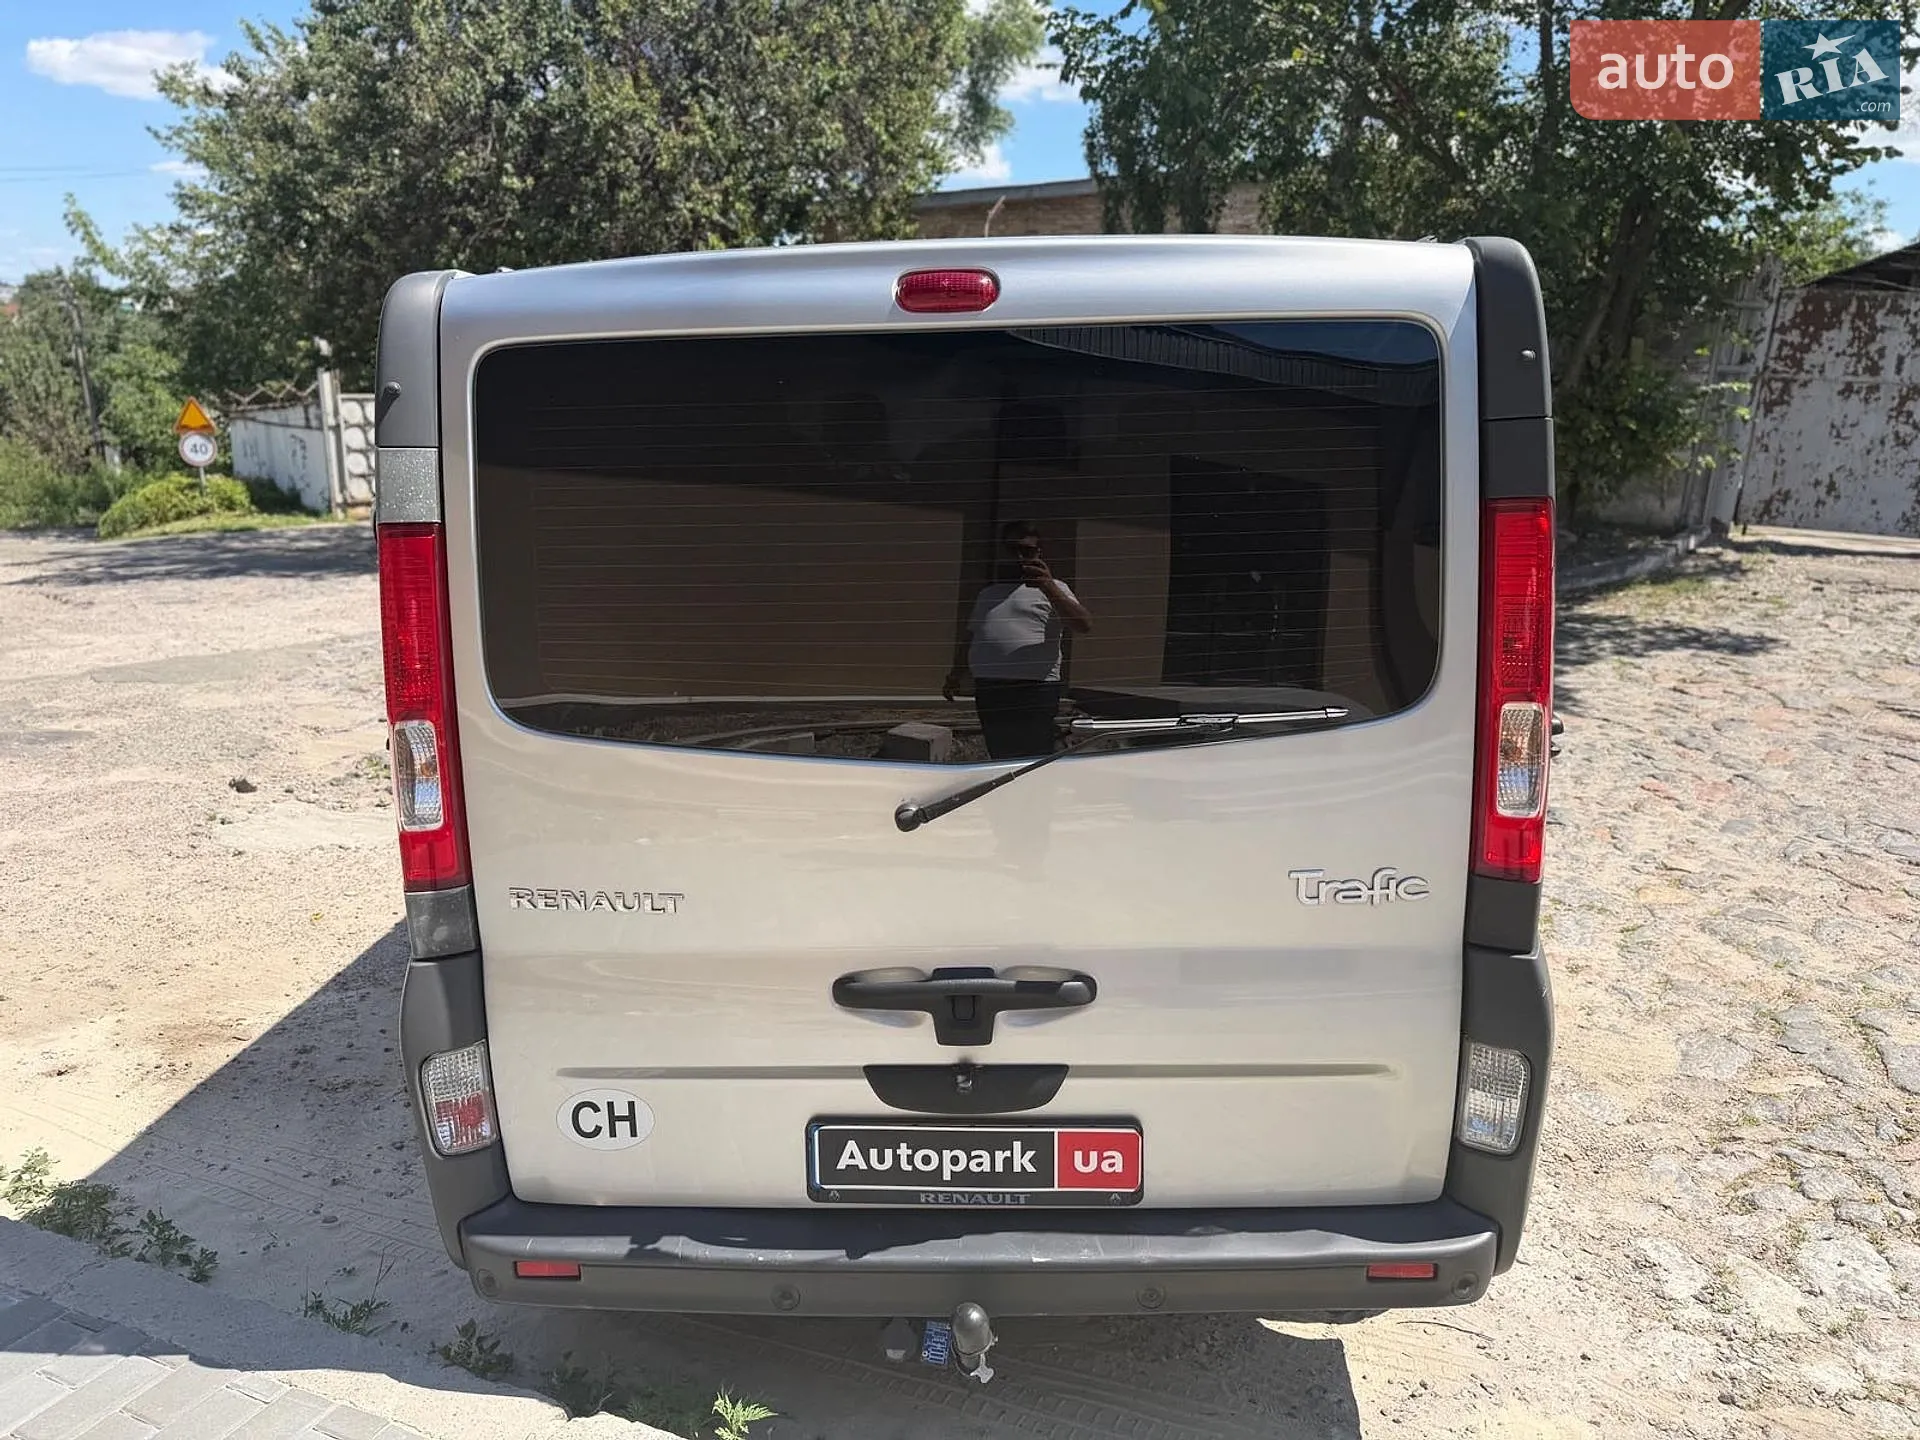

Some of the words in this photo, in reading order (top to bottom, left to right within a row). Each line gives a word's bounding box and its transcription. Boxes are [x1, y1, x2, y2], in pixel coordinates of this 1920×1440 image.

[190, 443, 208, 455] 40
[509, 887, 684, 914] RENAULT
[1288, 867, 1431, 905] Trafic
[571, 1100, 638, 1138] CH
[835, 1139, 1037, 1181] Autopark
[1073, 1150, 1124, 1174] ua
[919, 1191, 1031, 1206] RENAULT
